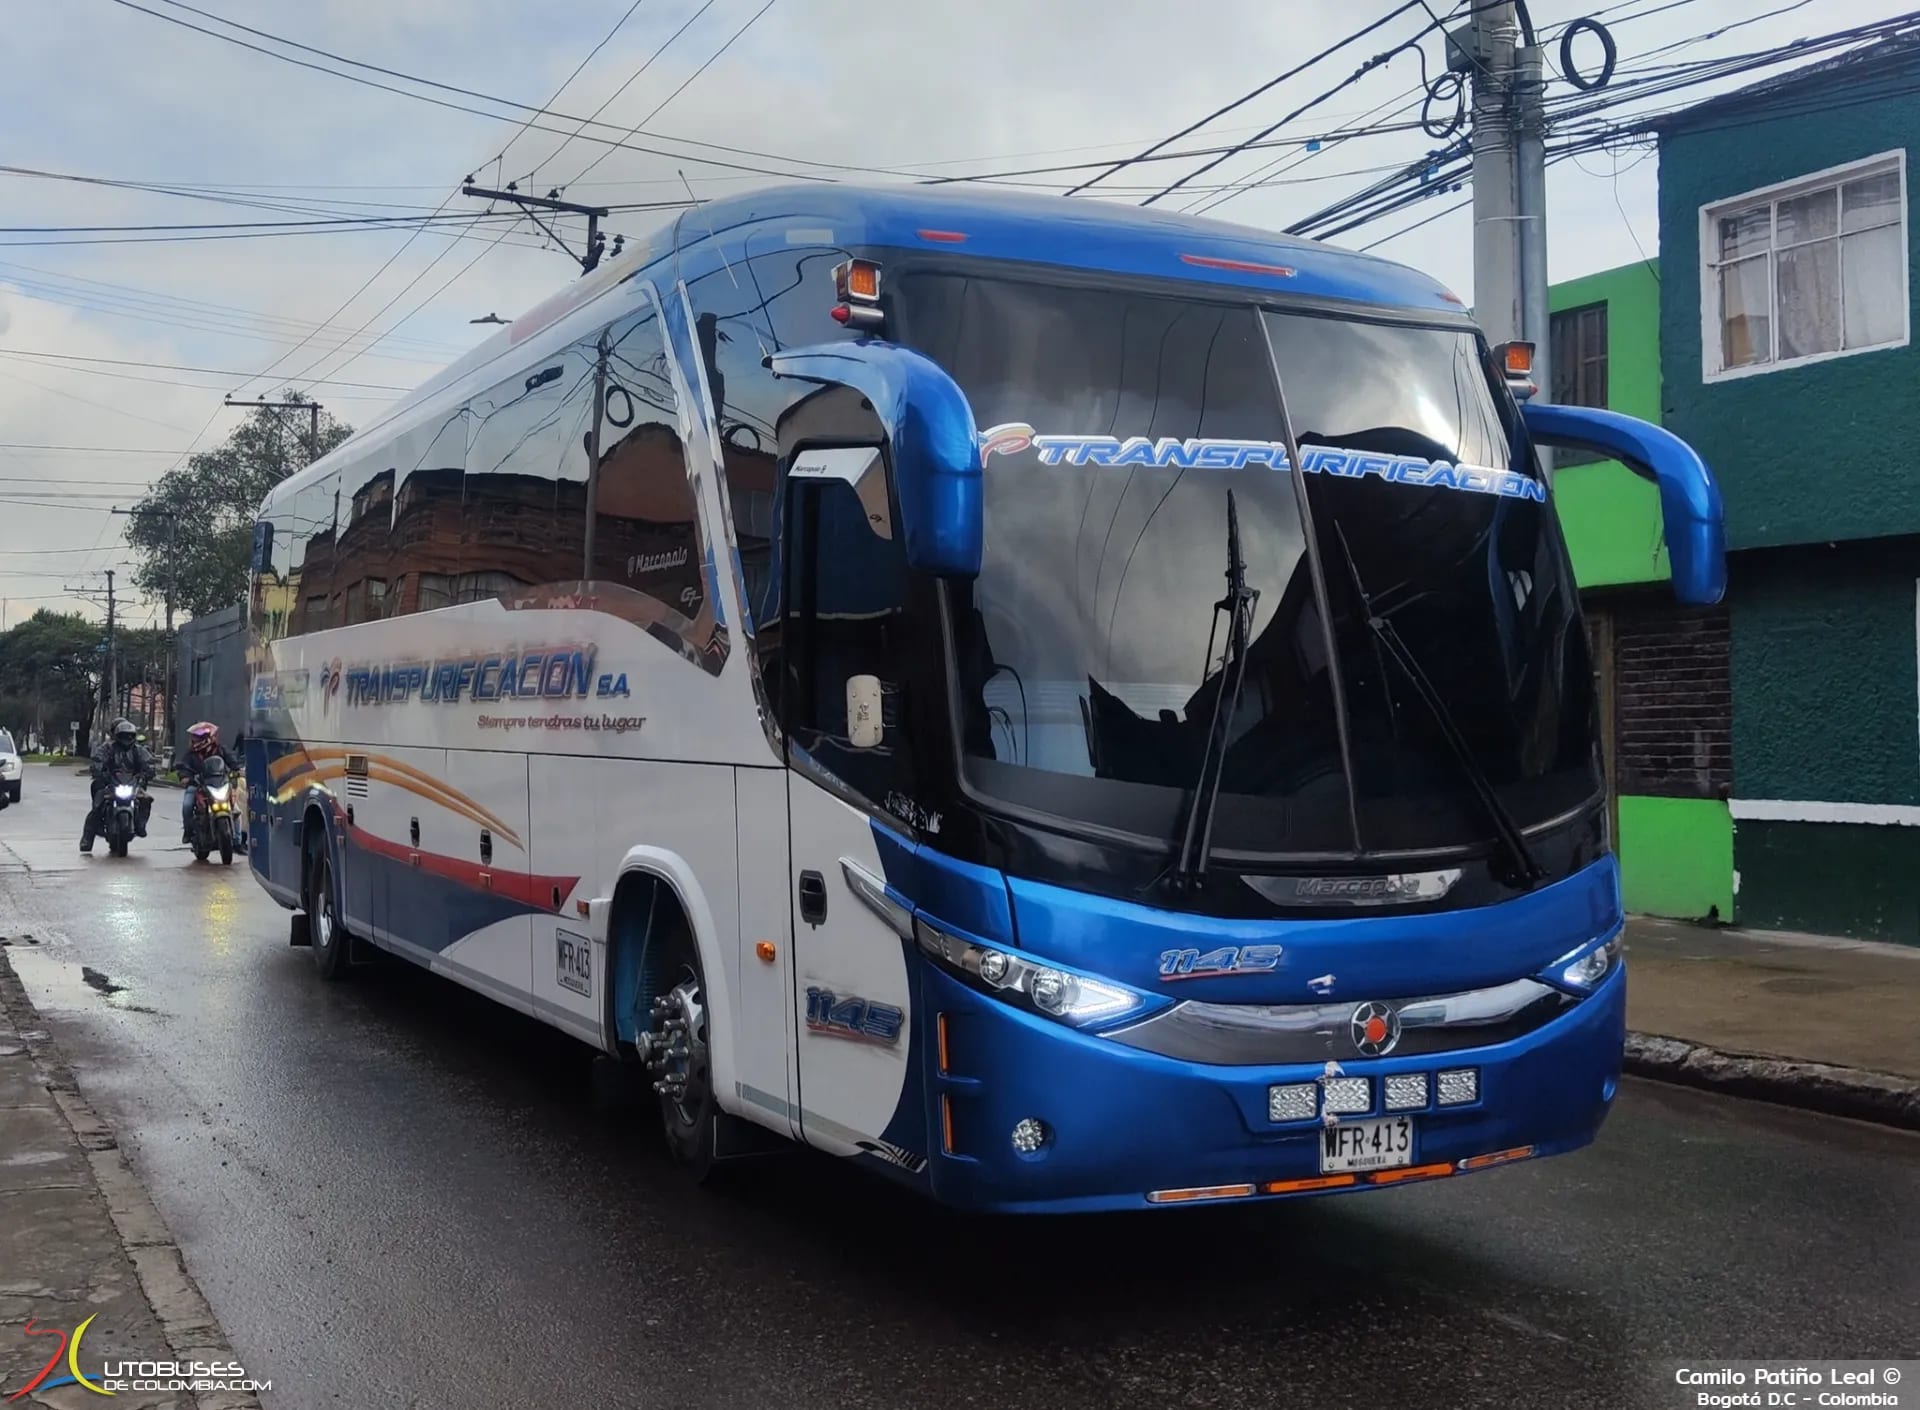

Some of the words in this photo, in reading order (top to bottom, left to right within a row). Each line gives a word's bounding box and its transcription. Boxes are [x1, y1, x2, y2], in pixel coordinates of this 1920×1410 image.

[1032, 435, 1546, 503] TRANSPURIFICACION
[346, 647, 597, 706] TRANSPURIFICACION
[477, 714, 526, 732] Siempre
[528, 713, 583, 729] tendras
[584, 715, 600, 730] tu
[602, 713, 646, 734] lugar
[1159, 945, 1283, 974] 1145
[806, 986, 905, 1044] 1145
